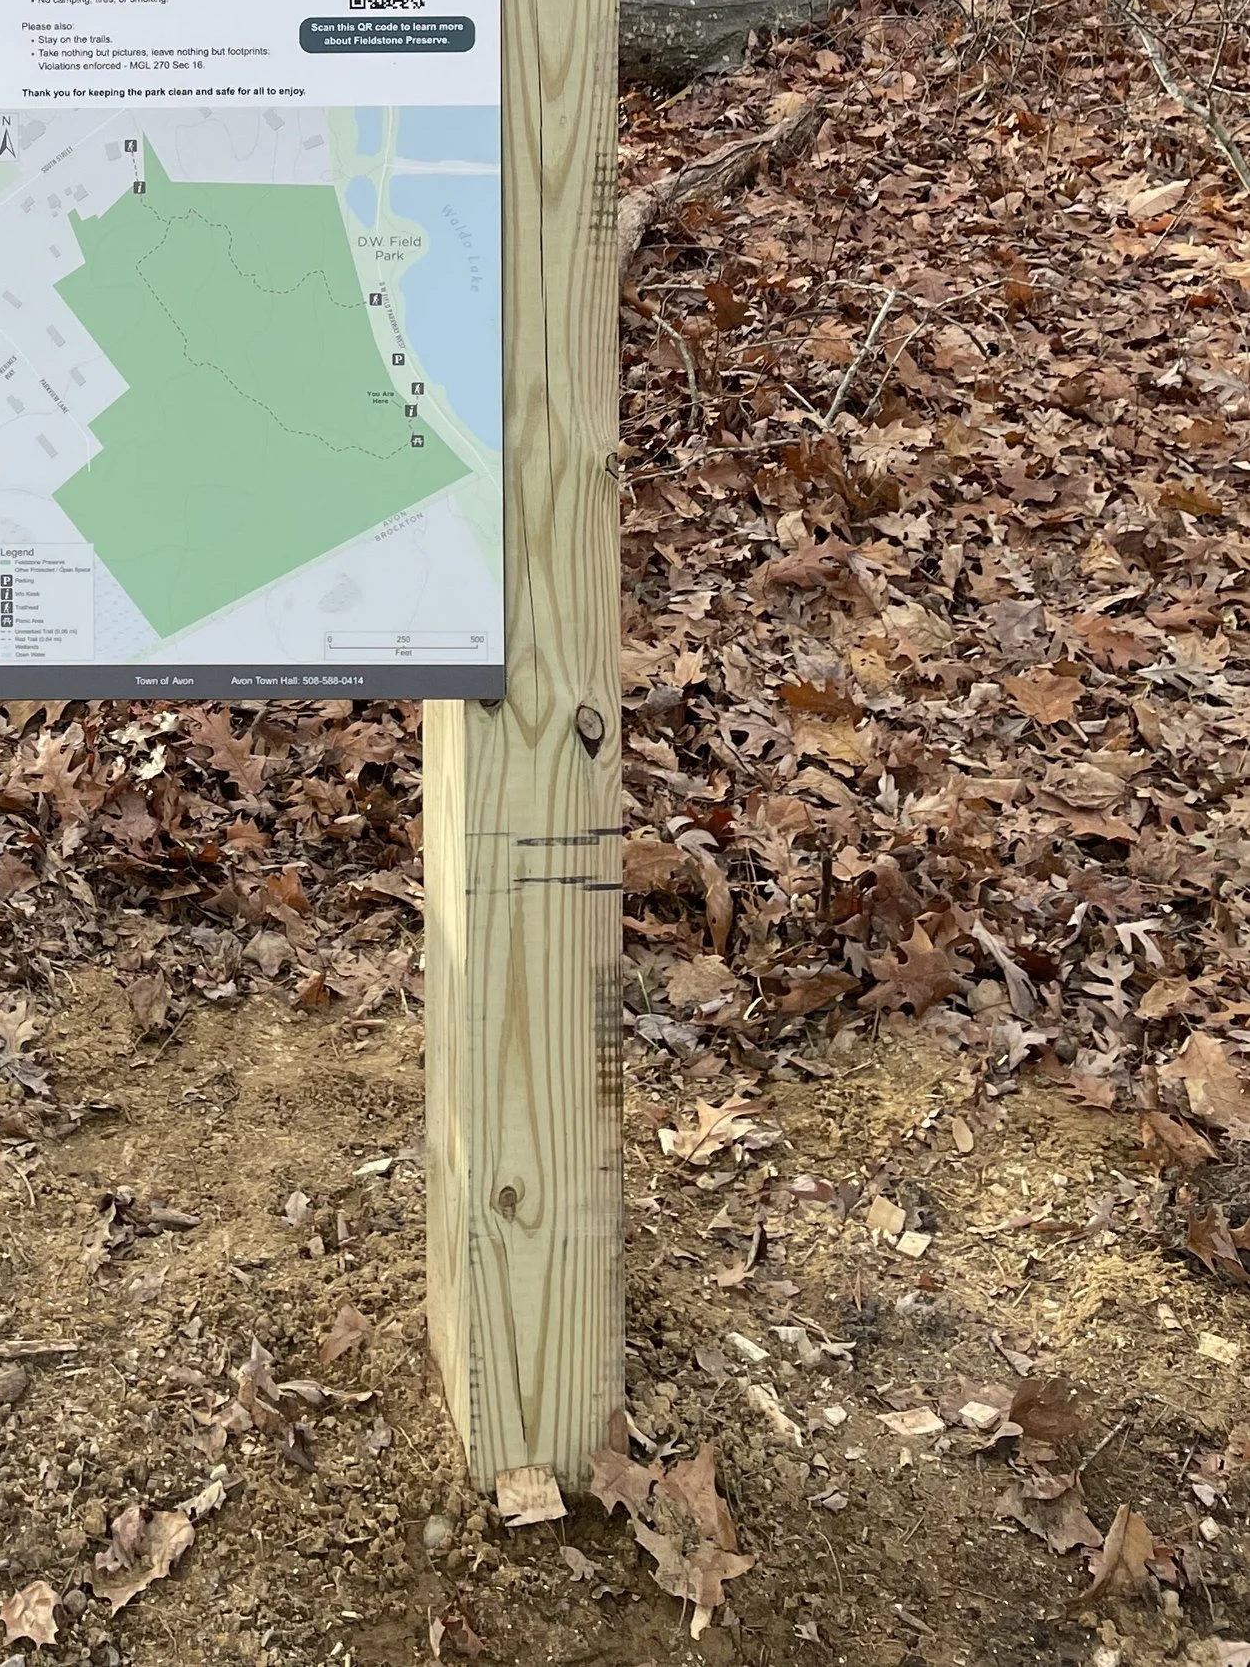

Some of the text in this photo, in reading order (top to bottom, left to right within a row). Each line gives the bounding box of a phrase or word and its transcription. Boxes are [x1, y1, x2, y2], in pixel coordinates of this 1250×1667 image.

[311, 23, 334, 31] Scan
[337, 22, 354, 31] this
[358, 22, 372, 31] QR
[375, 22, 397, 31] code
[413, 22, 436, 30] learn
[324, 35, 450, 44] about Fieldstone Preserve.
[37, 48, 59, 57] Take
[61, 48, 93, 58] nothing
[95, 48, 109, 56] but
[111, 48, 148, 58] pictures,
[151, 48, 174, 56] leave
[176, 47, 209, 57] nothing
[211, 47, 225, 55] but
[21, 86, 306, 98] Thank you for keeping the park clean and safe for all to enjoy.
[358, 236, 421, 247] D.W. Field
[442, 203, 484, 293] Waldo Lake
[375, 251, 404, 261] Park
[374, 512, 424, 542] BROCKTON
[0, 548, 34, 558] Legend
[135, 676, 193, 685] Town of Avon
[231, 676, 363, 685] Avon Town Hall: 508-588-0414
